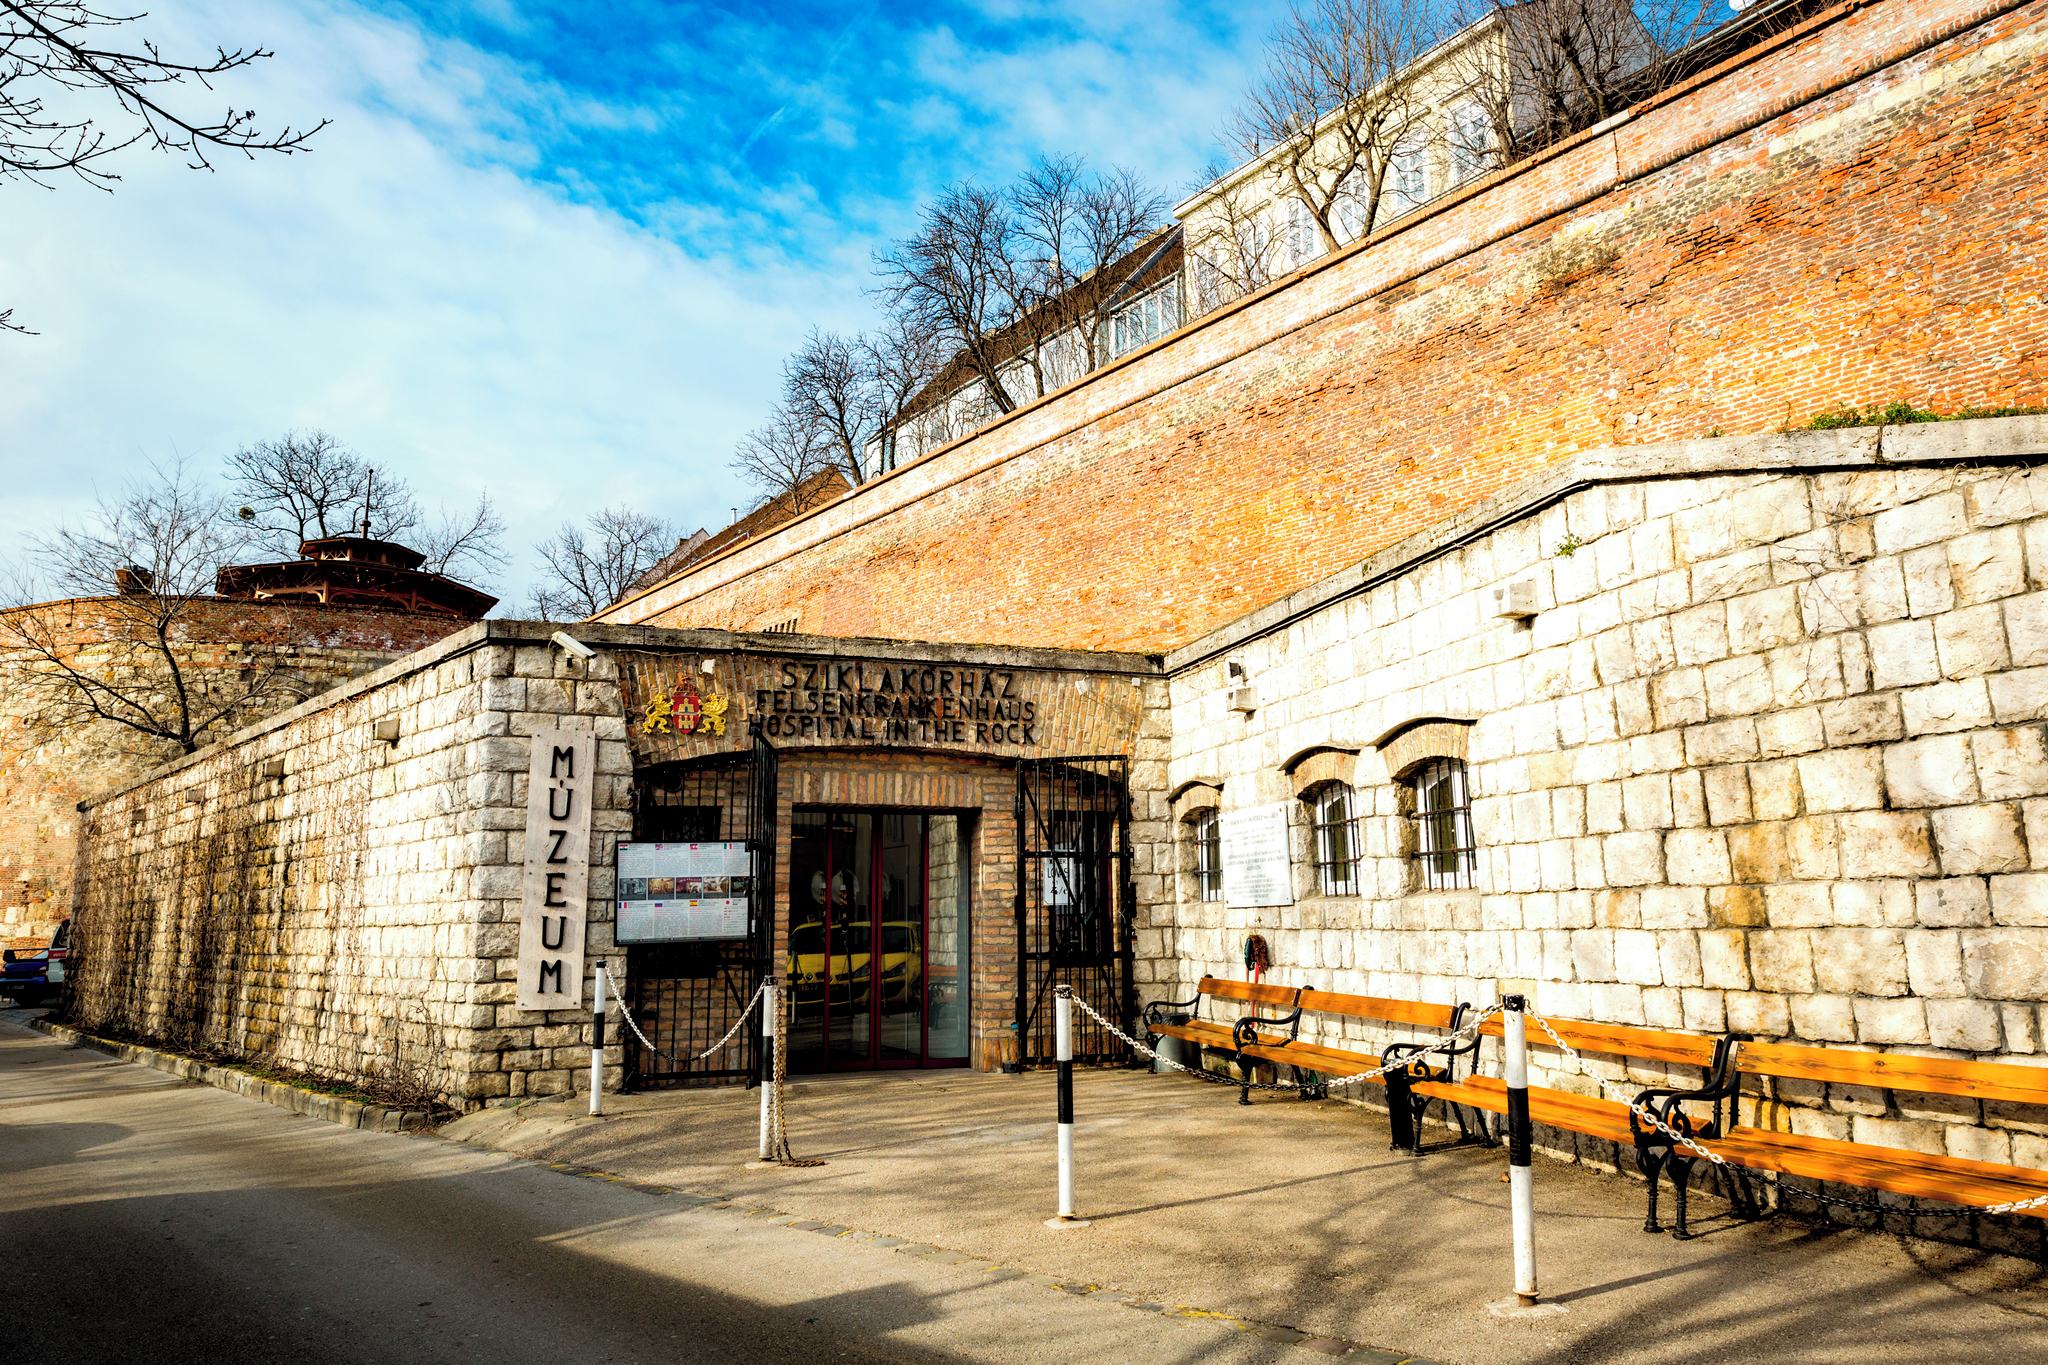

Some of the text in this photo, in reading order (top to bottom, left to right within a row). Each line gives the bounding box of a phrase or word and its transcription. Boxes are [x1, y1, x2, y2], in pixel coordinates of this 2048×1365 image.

[756, 689, 1035, 721] FELSENKRANKENHAUS
[747, 713, 1036, 745] HOSPITAL IN THE ROCK
[537, 745, 575, 994] MÚZEUM
